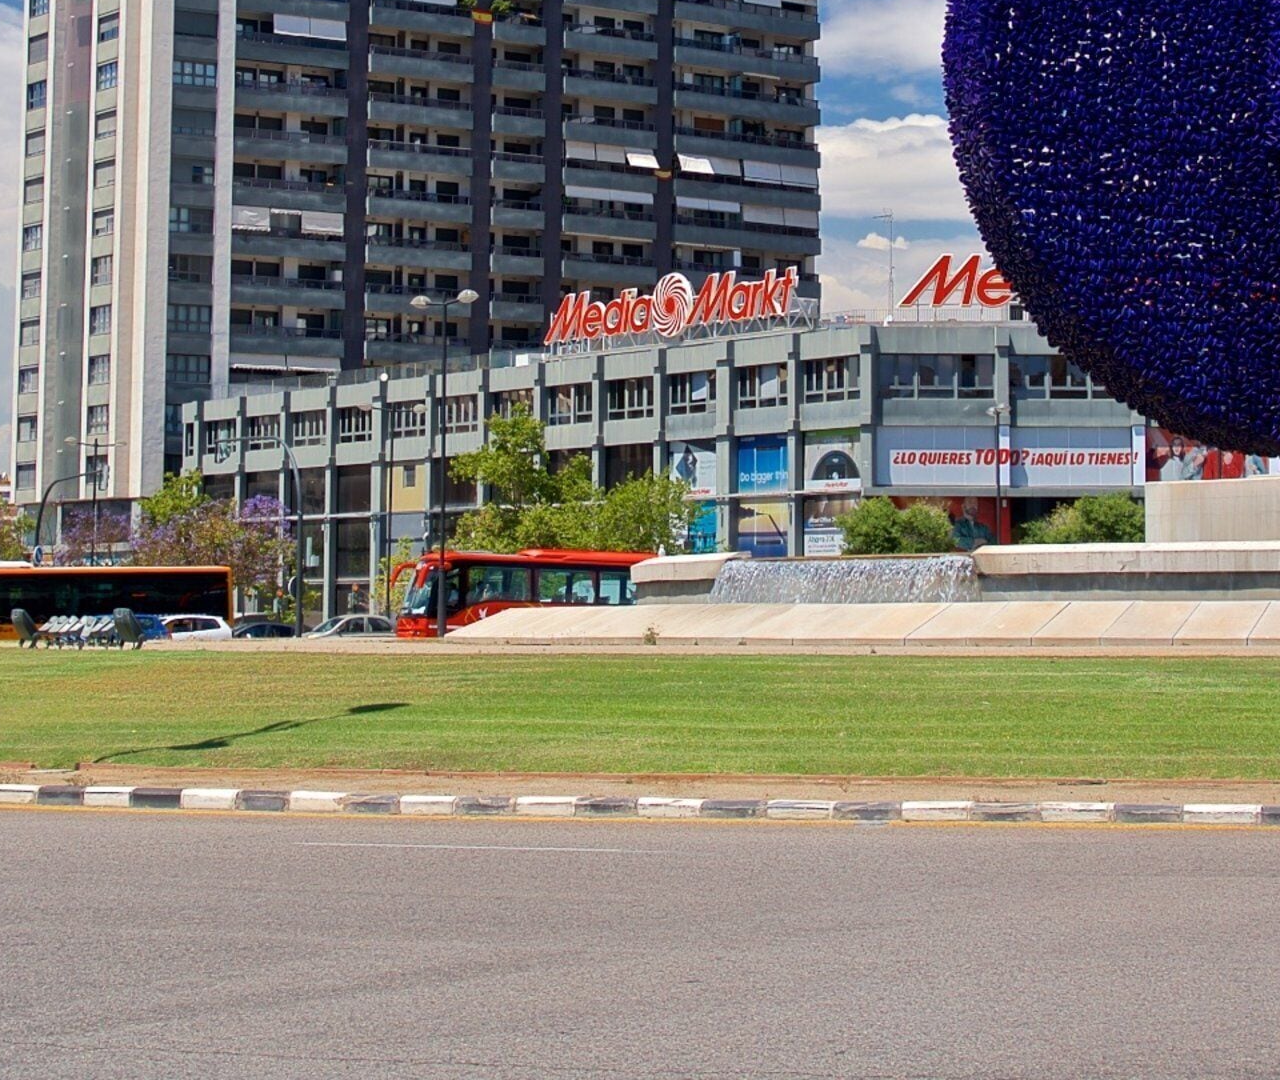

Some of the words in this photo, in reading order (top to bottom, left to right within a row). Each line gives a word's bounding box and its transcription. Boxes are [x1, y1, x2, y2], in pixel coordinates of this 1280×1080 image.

[898, 253, 1016, 308] Me
[544, 288, 654, 345] Media
[686, 266, 799, 326] Markt
[893, 452, 916, 465] ¿LO
[918, 452, 972, 466] QUIERES
[975, 448, 1030, 466] TODO?
[1030, 450, 1068, 466] ¡AQUÍ
[1068, 452, 1085, 465] LO
[1087, 452, 1138, 465] TIENES!
[740, 471, 750, 482] Do
[751, 471, 773, 484] bigger
